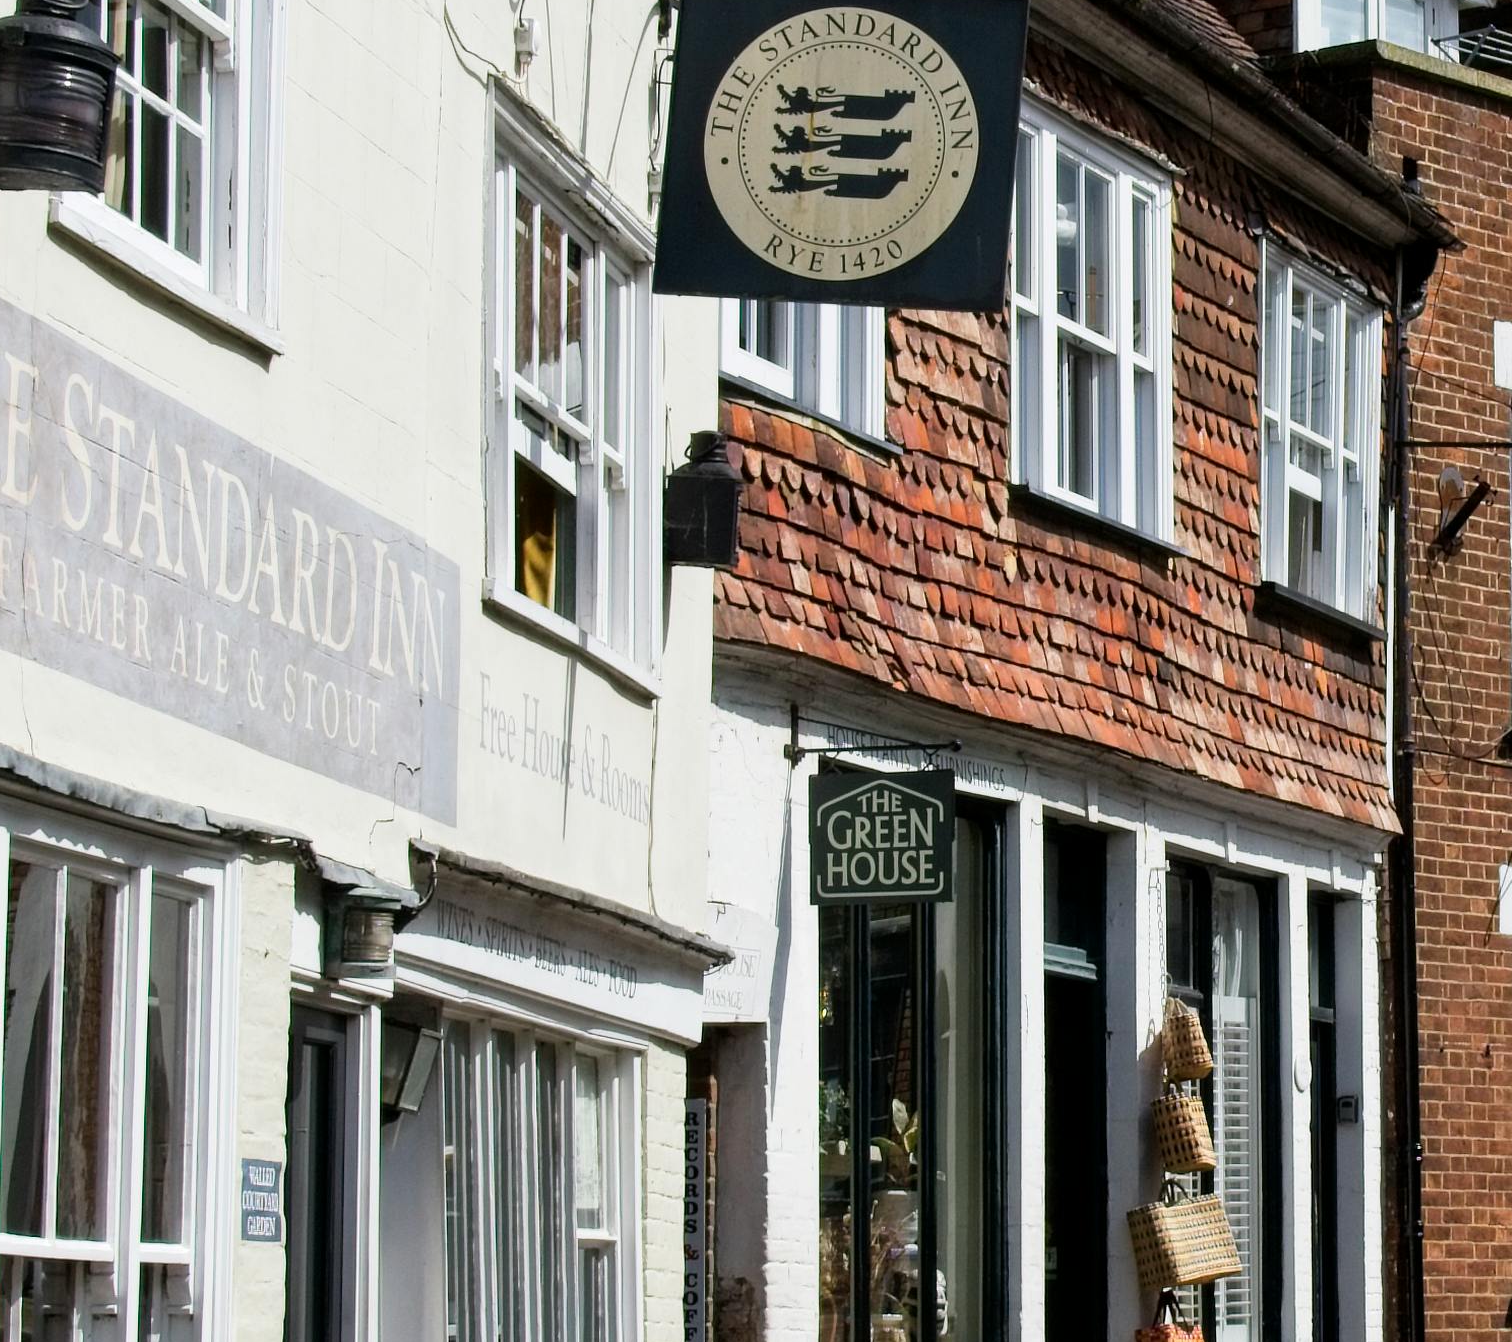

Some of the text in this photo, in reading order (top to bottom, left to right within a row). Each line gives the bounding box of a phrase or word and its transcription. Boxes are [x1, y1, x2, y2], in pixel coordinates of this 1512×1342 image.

[711, 12, 974, 150] THE STANDARD INN
[764, 234, 903, 274] RYE 1420
[61, 371, 358, 652] STANDARD
[369, 538, 446, 701] INN
[170, 614, 231, 695] ALE
[246, 647, 265, 711] &
[283, 663, 381, 756] STOUT
[479, 671, 650, 826] Free House & Rooms
[857, 790, 903, 813] THE
[827, 807, 934, 850] GREEN
[827, 850, 935, 887] HOUSE
[437, 899, 474, 947] WINES
[535, 933, 567, 977] BEERS
[575, 949, 600, 987] ALES
[608, 959, 637, 999] FOOD
[249, 1165, 276, 1187] WALLED
[247, 1215, 276, 1237] GARDEN
